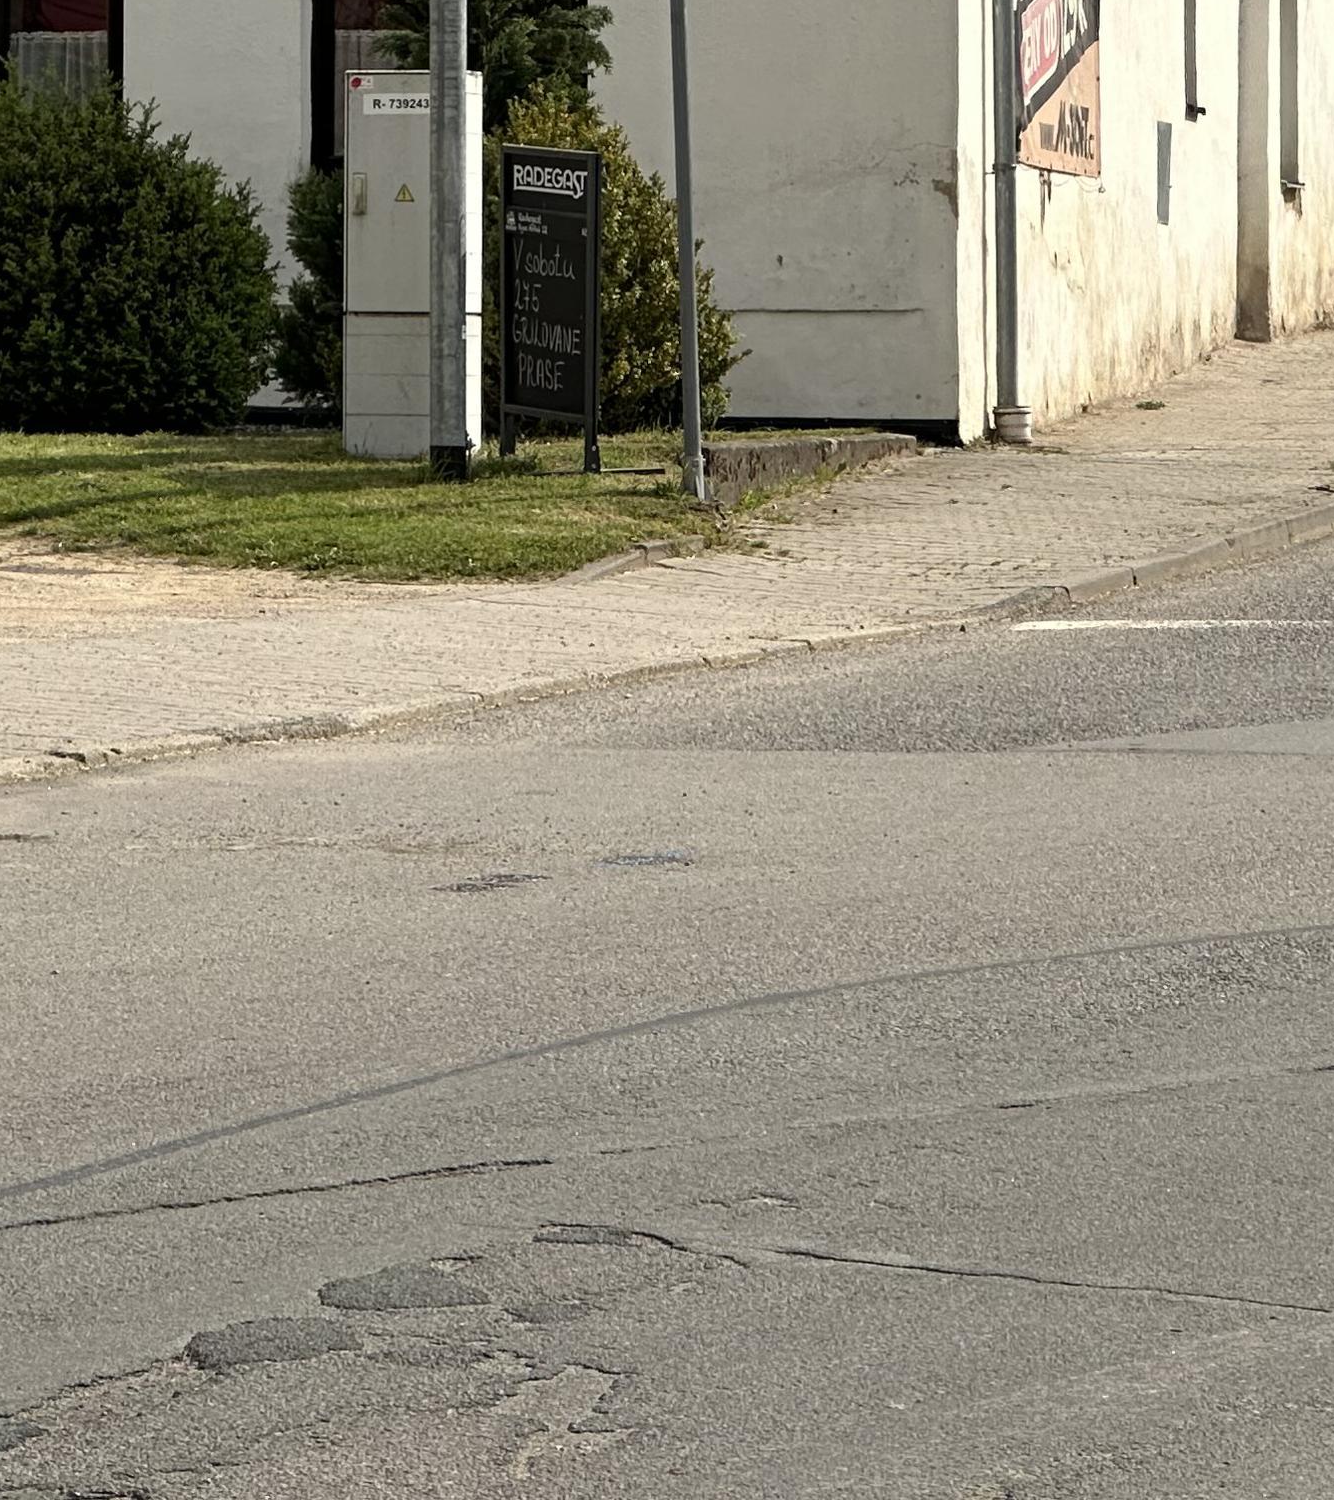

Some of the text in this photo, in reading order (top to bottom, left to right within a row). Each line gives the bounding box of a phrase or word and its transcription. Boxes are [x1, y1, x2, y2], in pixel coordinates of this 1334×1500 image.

[513, 164, 588, 199] RADEGAST
[524, 243, 576, 280] sobotu
[518, 351, 566, 392] PRASE
